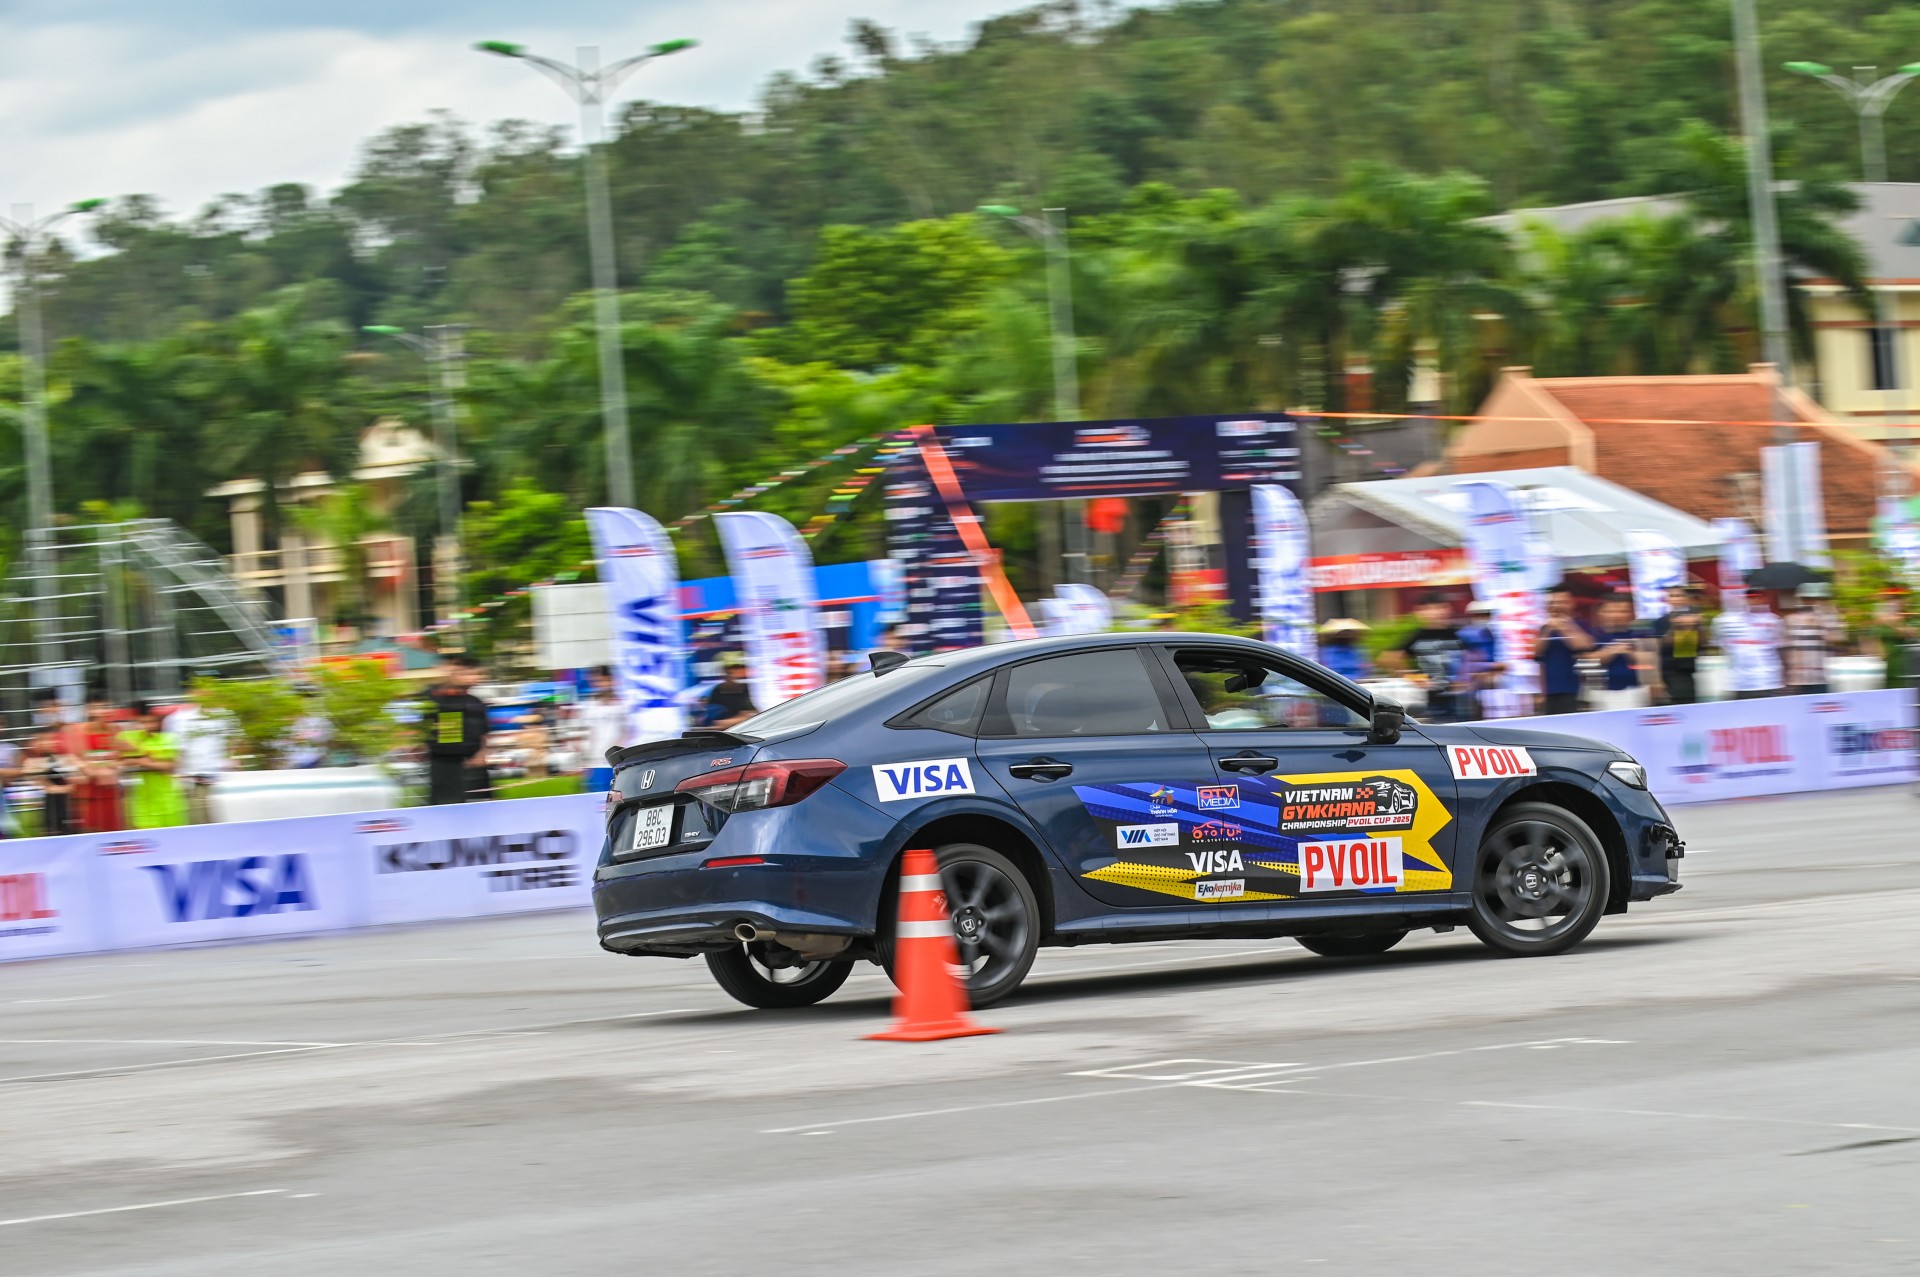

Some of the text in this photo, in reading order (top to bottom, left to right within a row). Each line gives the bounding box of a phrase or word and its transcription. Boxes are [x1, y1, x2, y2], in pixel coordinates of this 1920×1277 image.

[710, 757, 733, 768] RS
[1455, 748, 1530, 776] PVOIL
[880, 763, 968, 794] VISA
[1201, 797, 1238, 807] MEDIA
[1285, 787, 1354, 804] VIETNAM
[646, 809, 663, 827] 88C
[1282, 801, 1377, 820] GYMKHANA
[1281, 815, 1410, 830] CHAMPIONSHIP PVOIL CUP 2025
[637, 827, 667, 847] 296.03
[374, 830, 580, 874] KUMHO
[1184, 849, 1245, 873] VISA
[1305, 841, 1398, 888] PVOIL
[137, 853, 319, 923] VISA
